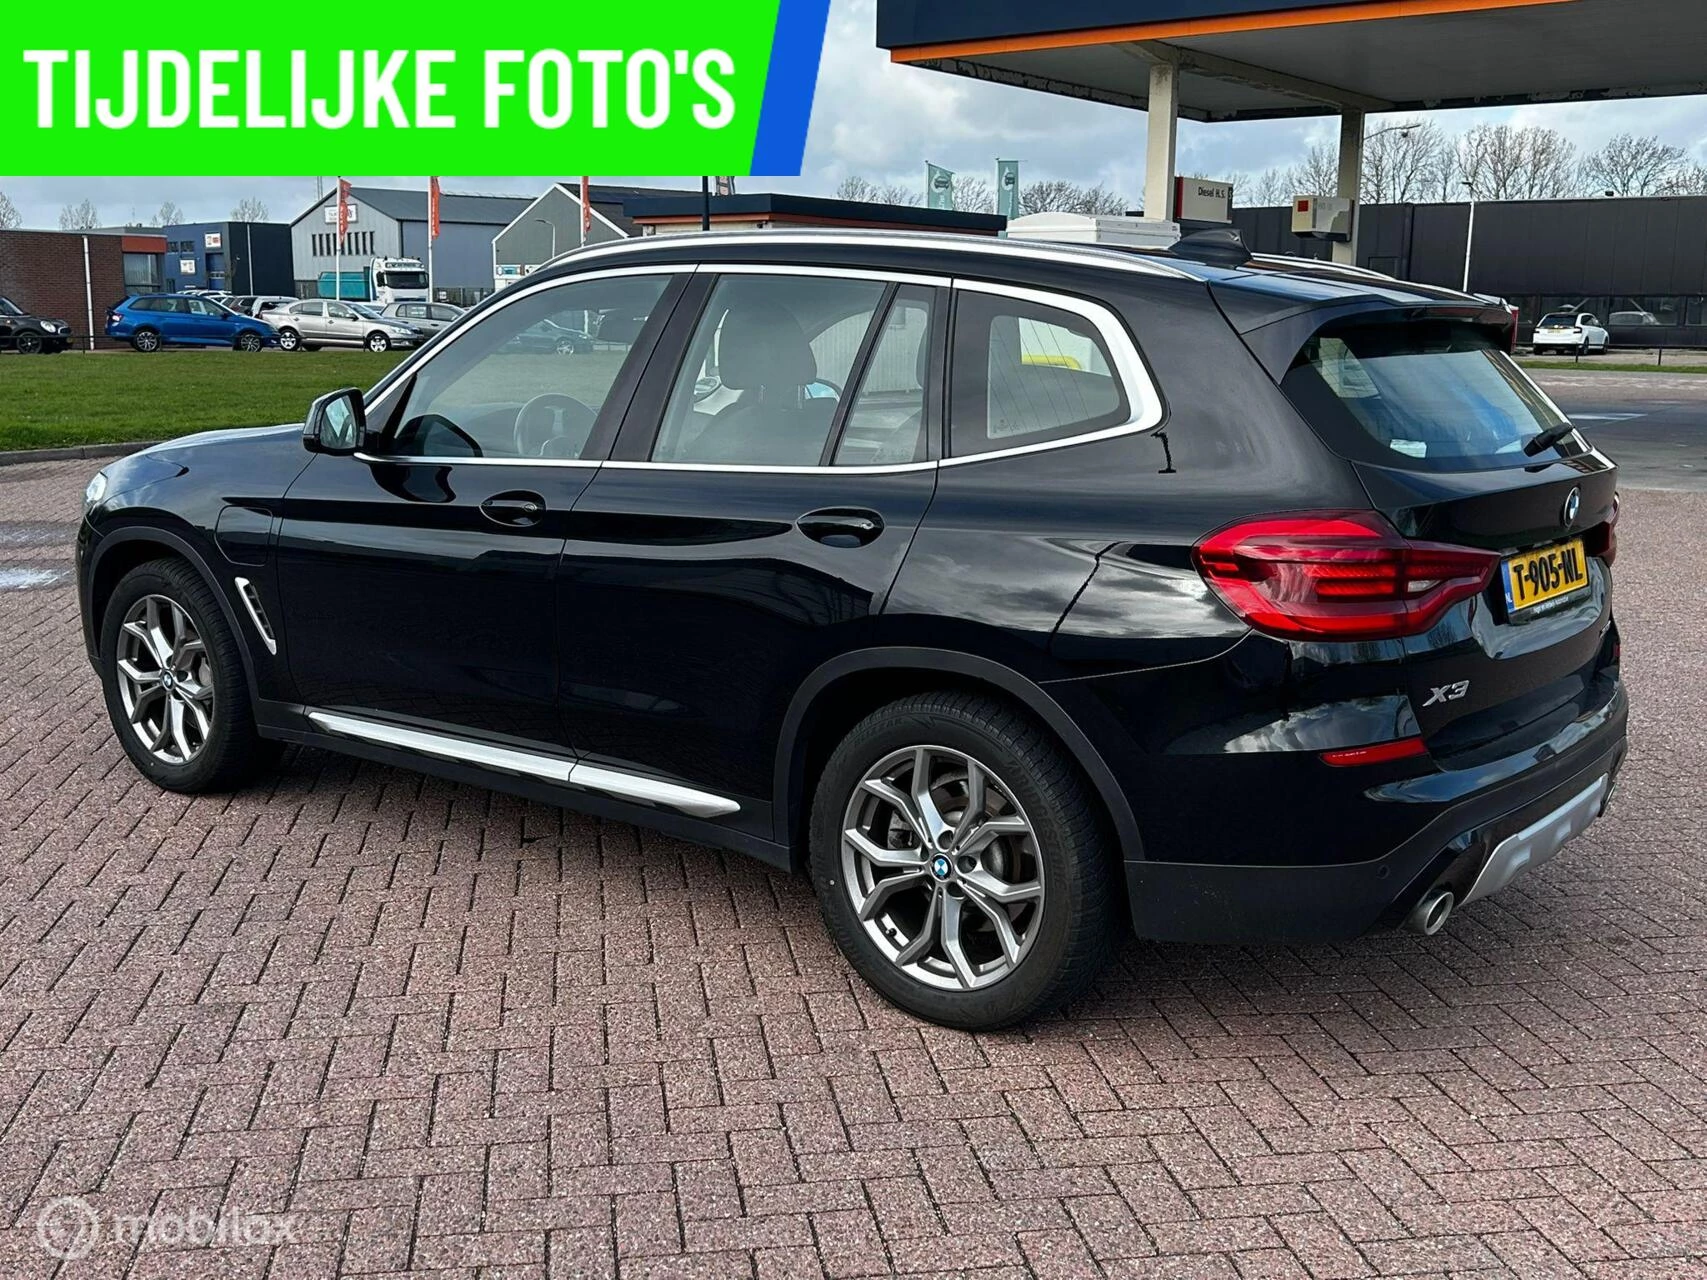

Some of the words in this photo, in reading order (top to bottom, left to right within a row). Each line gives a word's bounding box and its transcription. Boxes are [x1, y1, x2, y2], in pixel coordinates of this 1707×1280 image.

[1198, 186, 1214, 197] Diesel
[1513, 547, 1583, 601] T-905-NL
[1504, 592, 1513, 603] NL
[1422, 680, 1470, 707] X3
